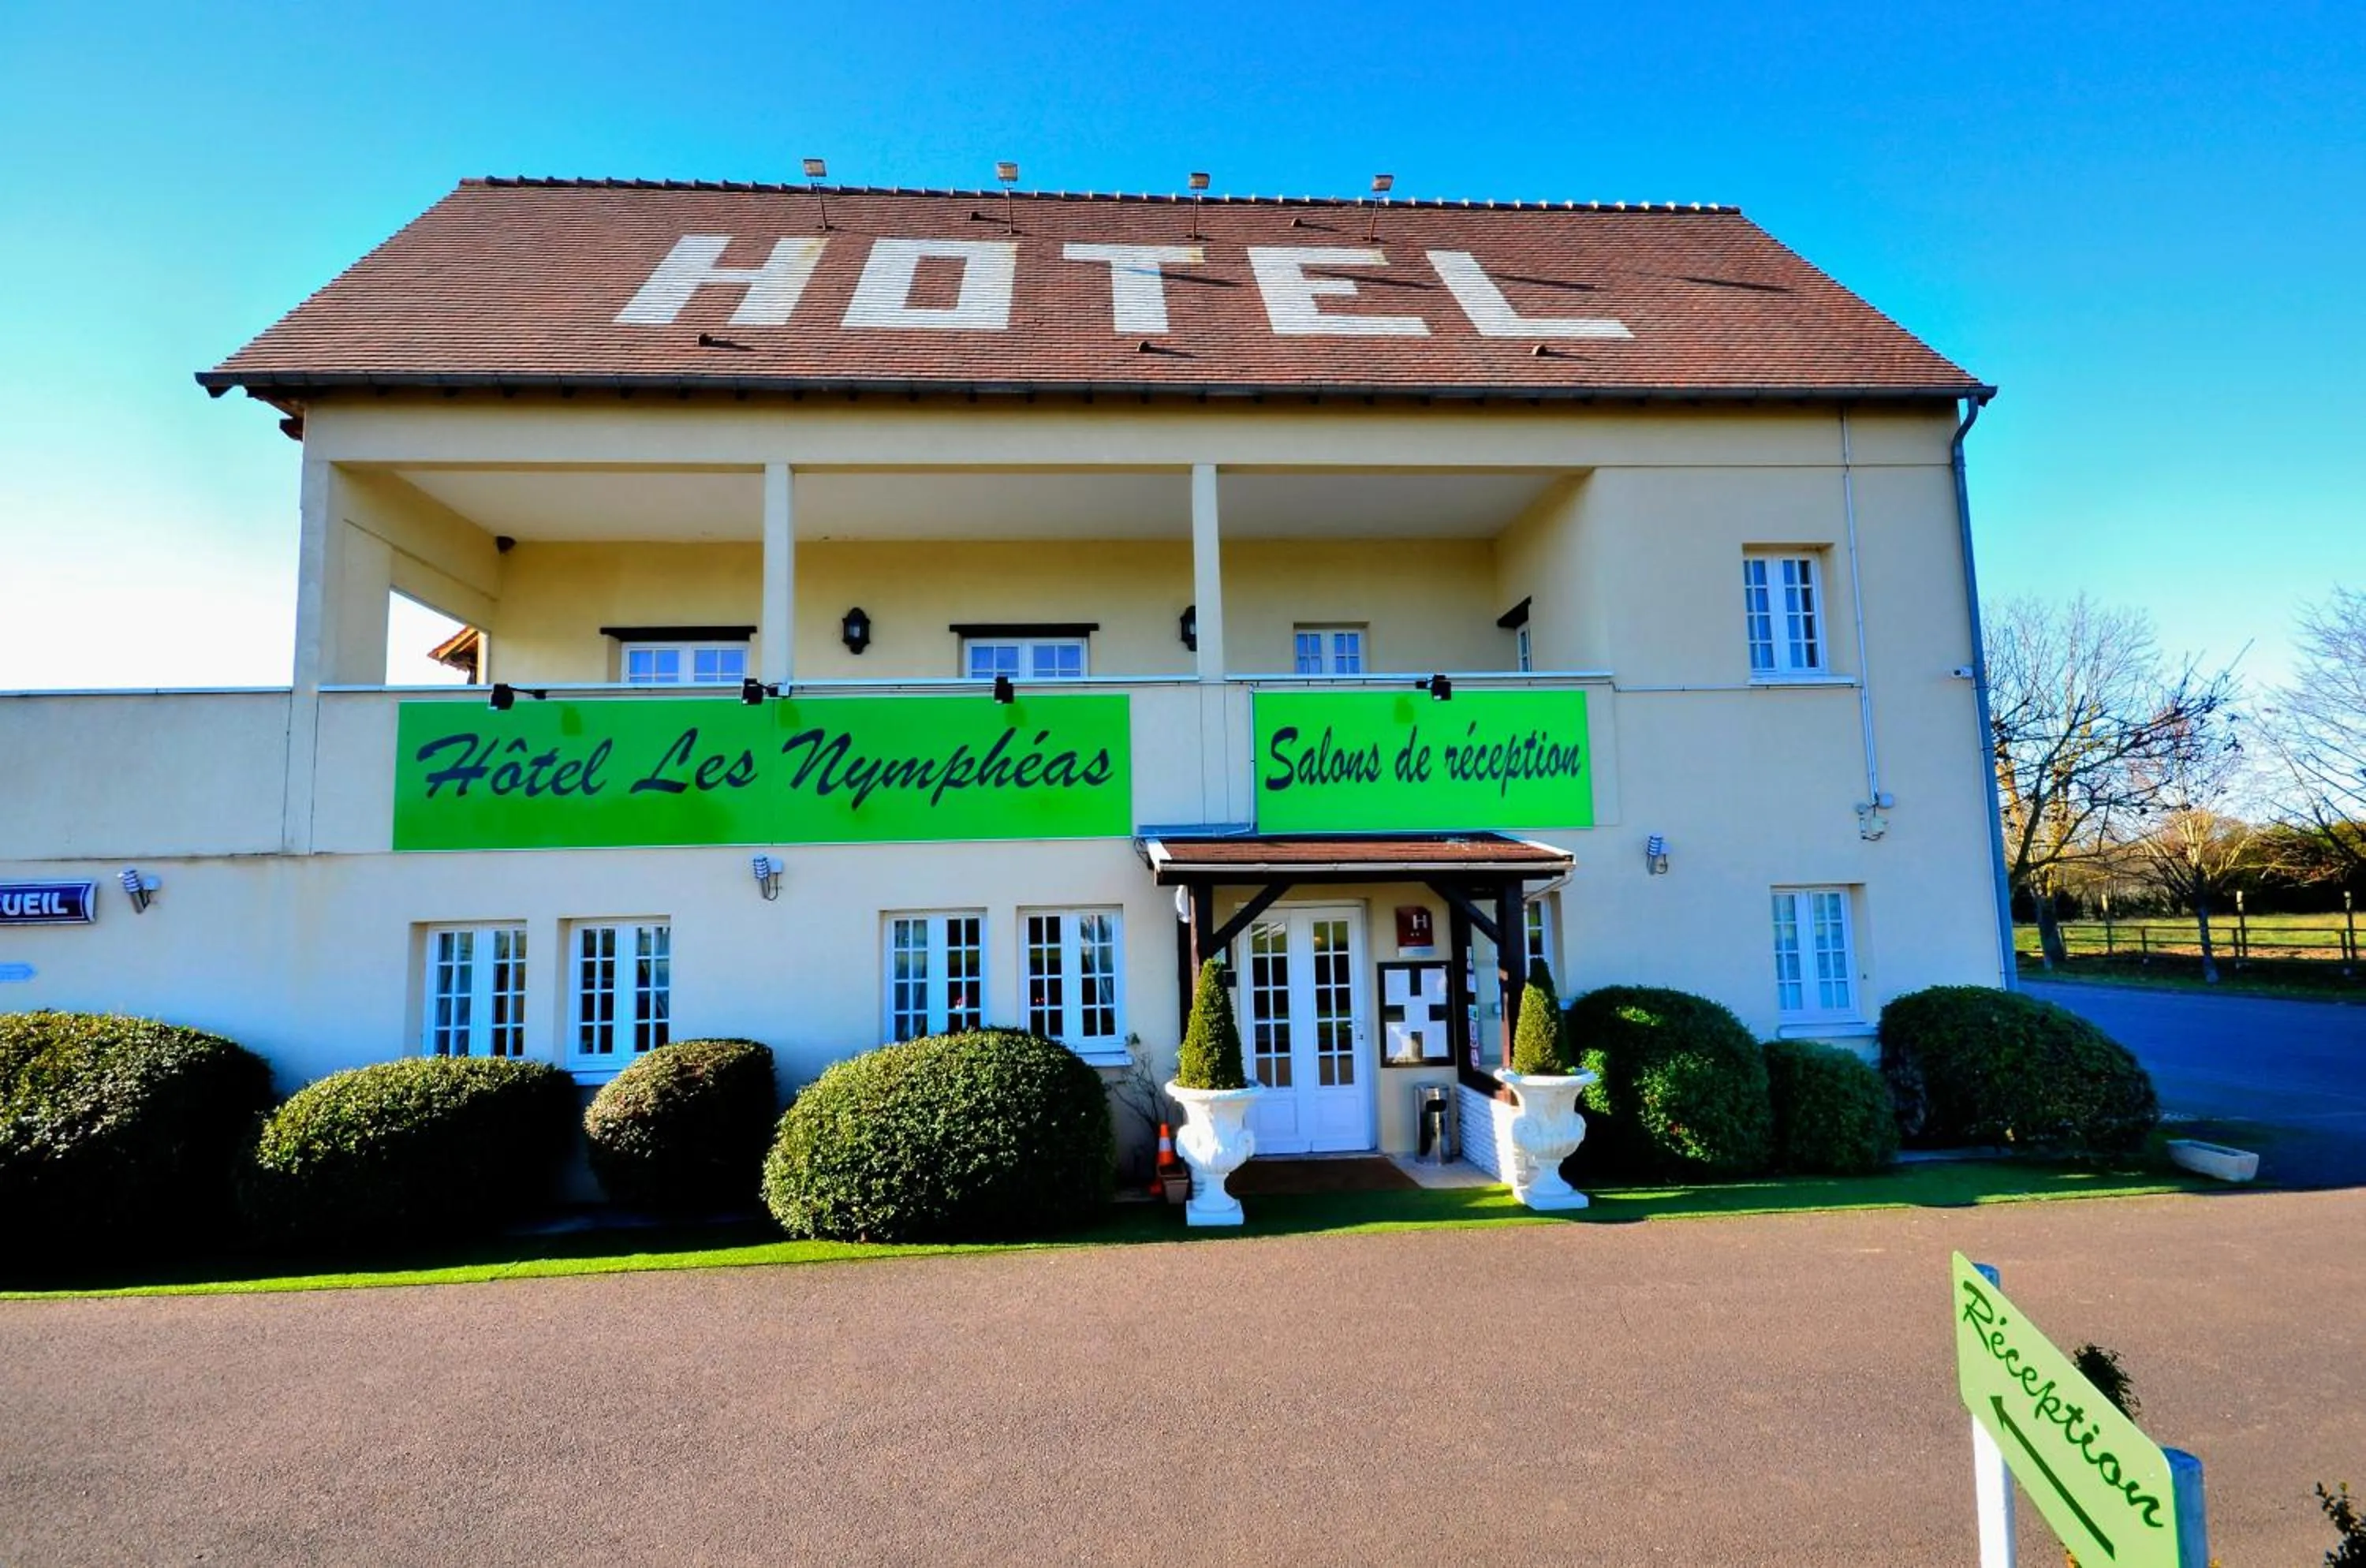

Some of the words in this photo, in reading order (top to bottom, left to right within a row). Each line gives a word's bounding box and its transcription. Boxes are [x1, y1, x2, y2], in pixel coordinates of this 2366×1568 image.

[613, 233, 1635, 338] HOTEL
[416, 732, 613, 799] Hôtel
[630, 726, 758, 793] Les
[781, 726, 1114, 811] Nymphéas
[1265, 725, 1383, 791] Salons
[1394, 724, 1432, 783] de
[1444, 720, 1580, 797] réception
[1413, 914, 1427, 930] H
[1962, 1279, 2164, 1529] Réception
